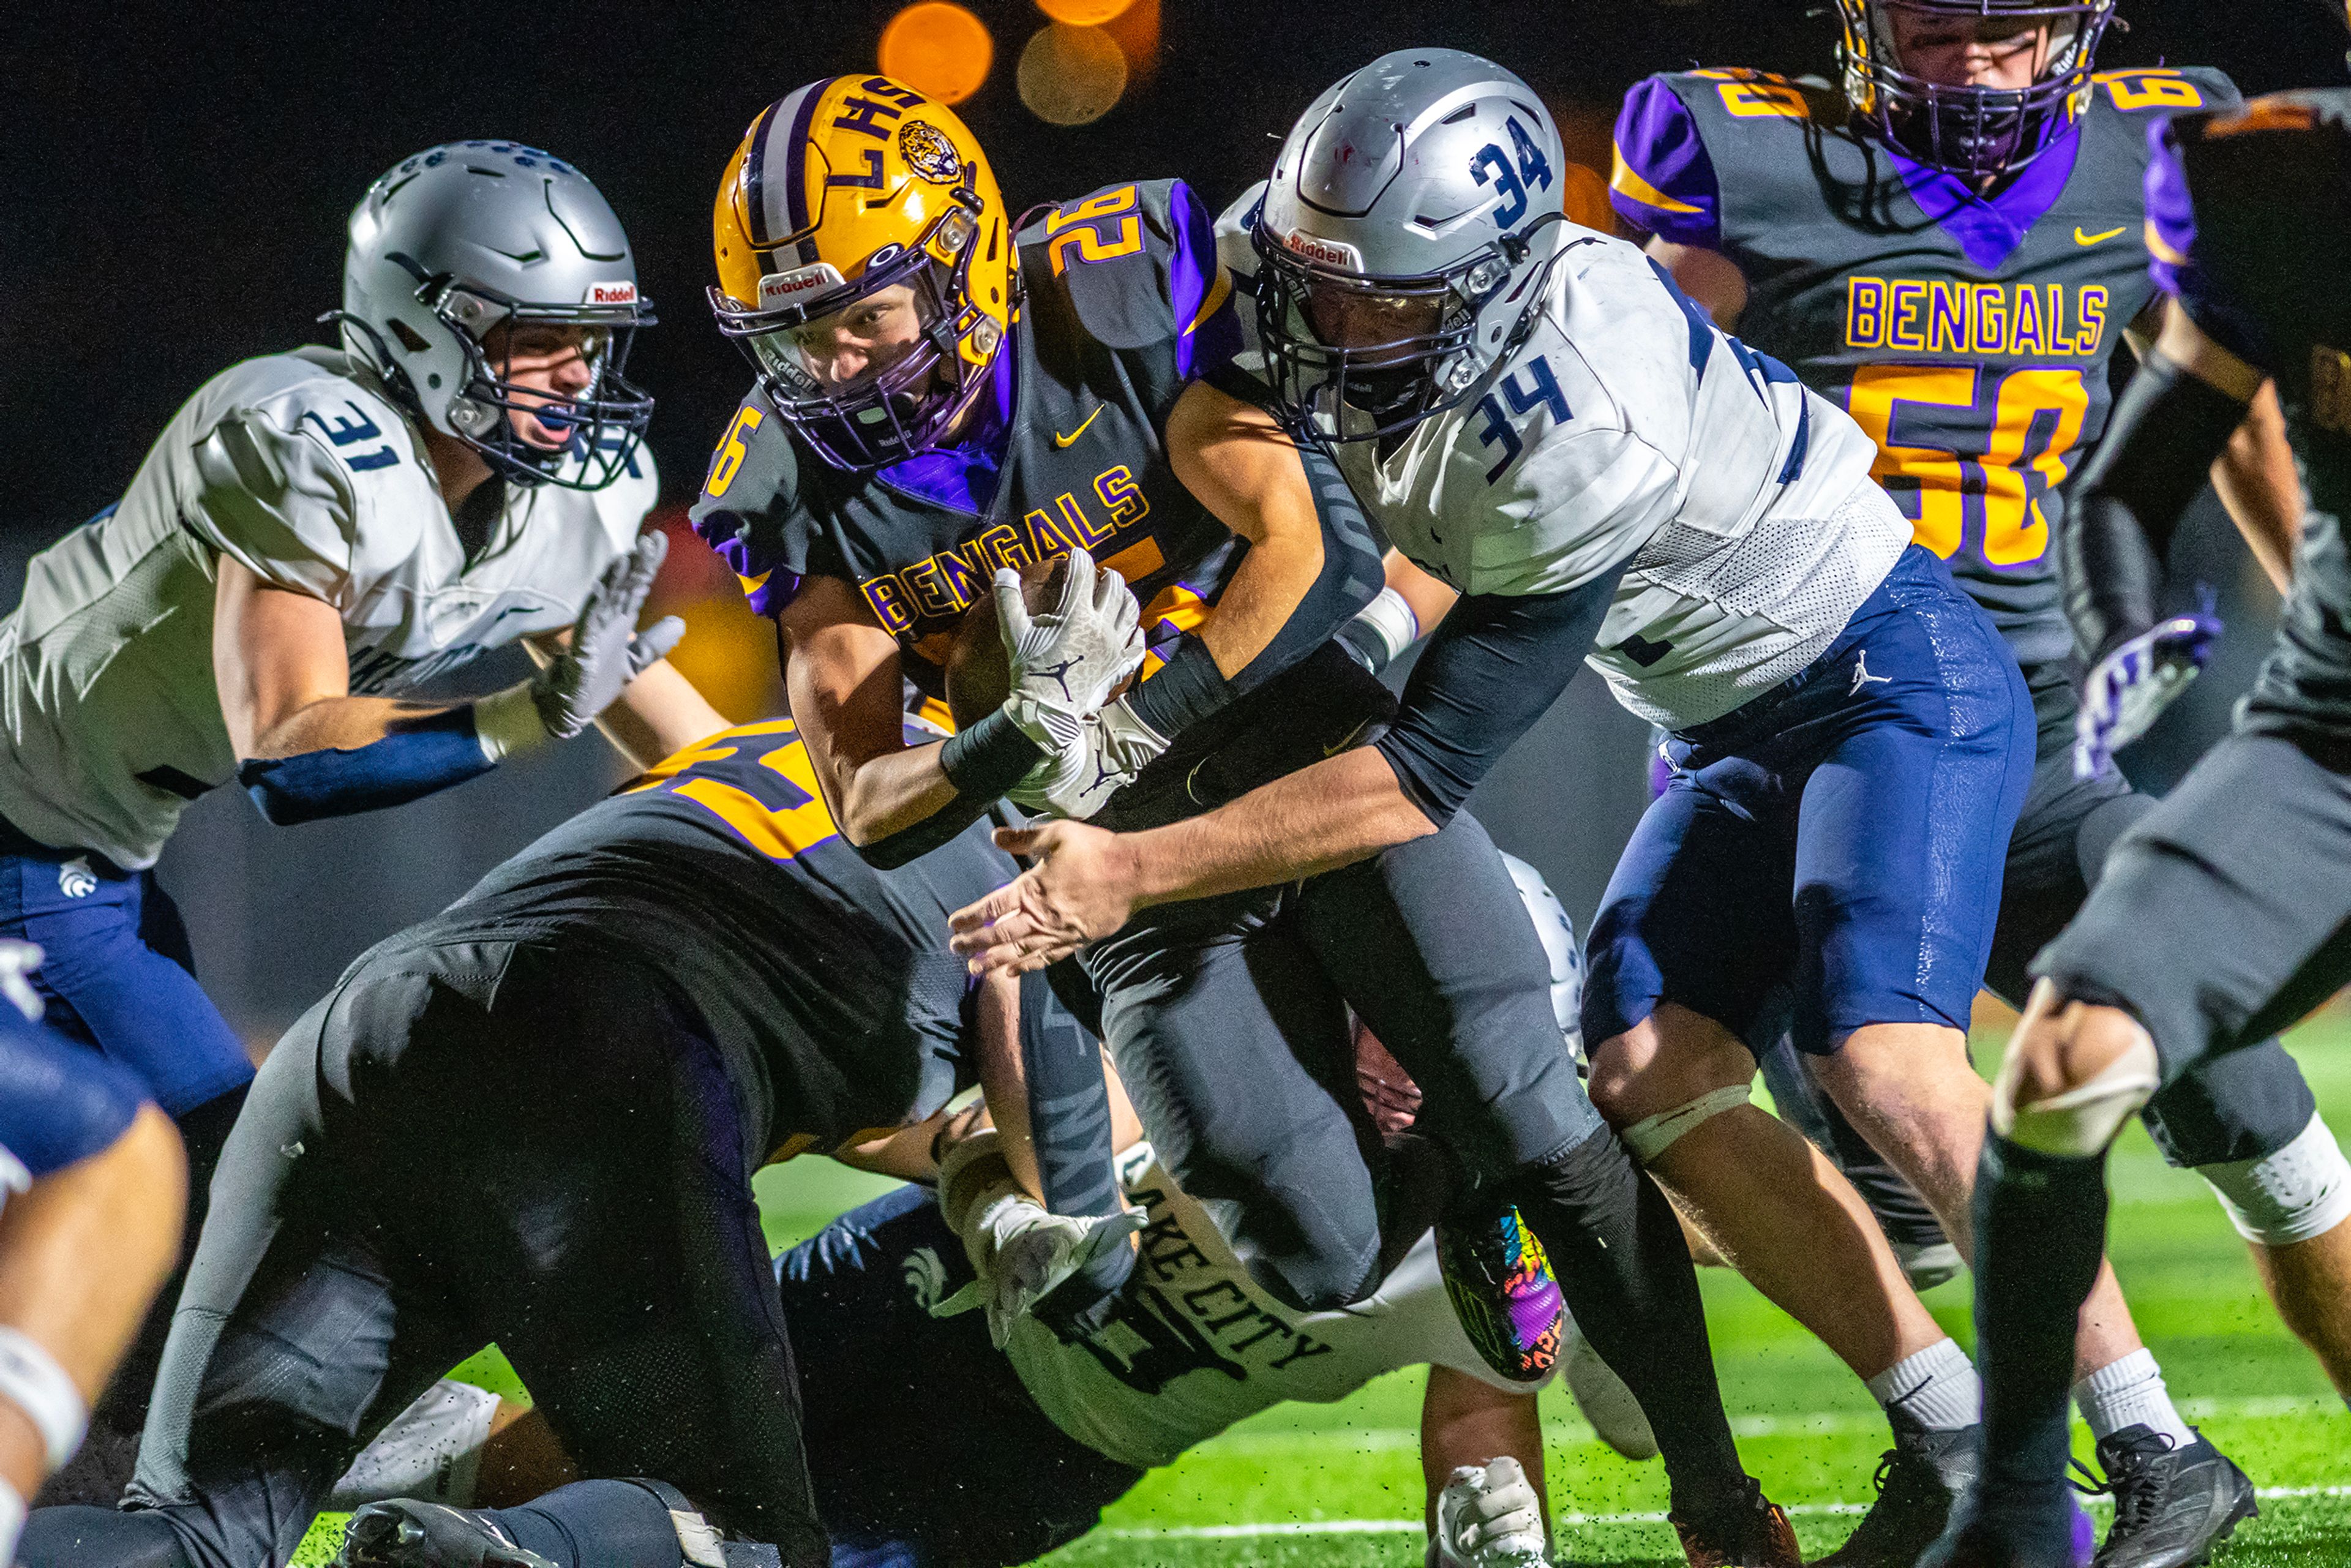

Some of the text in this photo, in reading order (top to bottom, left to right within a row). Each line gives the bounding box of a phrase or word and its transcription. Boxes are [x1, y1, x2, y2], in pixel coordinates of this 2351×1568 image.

[827, 77, 927, 189] LHS
[1469, 114, 1554, 231] 34
[1044, 182, 1147, 279] 26
[1290, 233, 1350, 266] Riddell
[765, 271, 828, 296] Riddell
[1845, 276, 2110, 356] BENGALS
[765, 348, 819, 391] Riddell
[302, 400, 401, 473] 31
[1458, 353, 1575, 487] 34
[860, 464, 1151, 637] BENGALS
[1182, 1280, 1333, 1370] CITY
